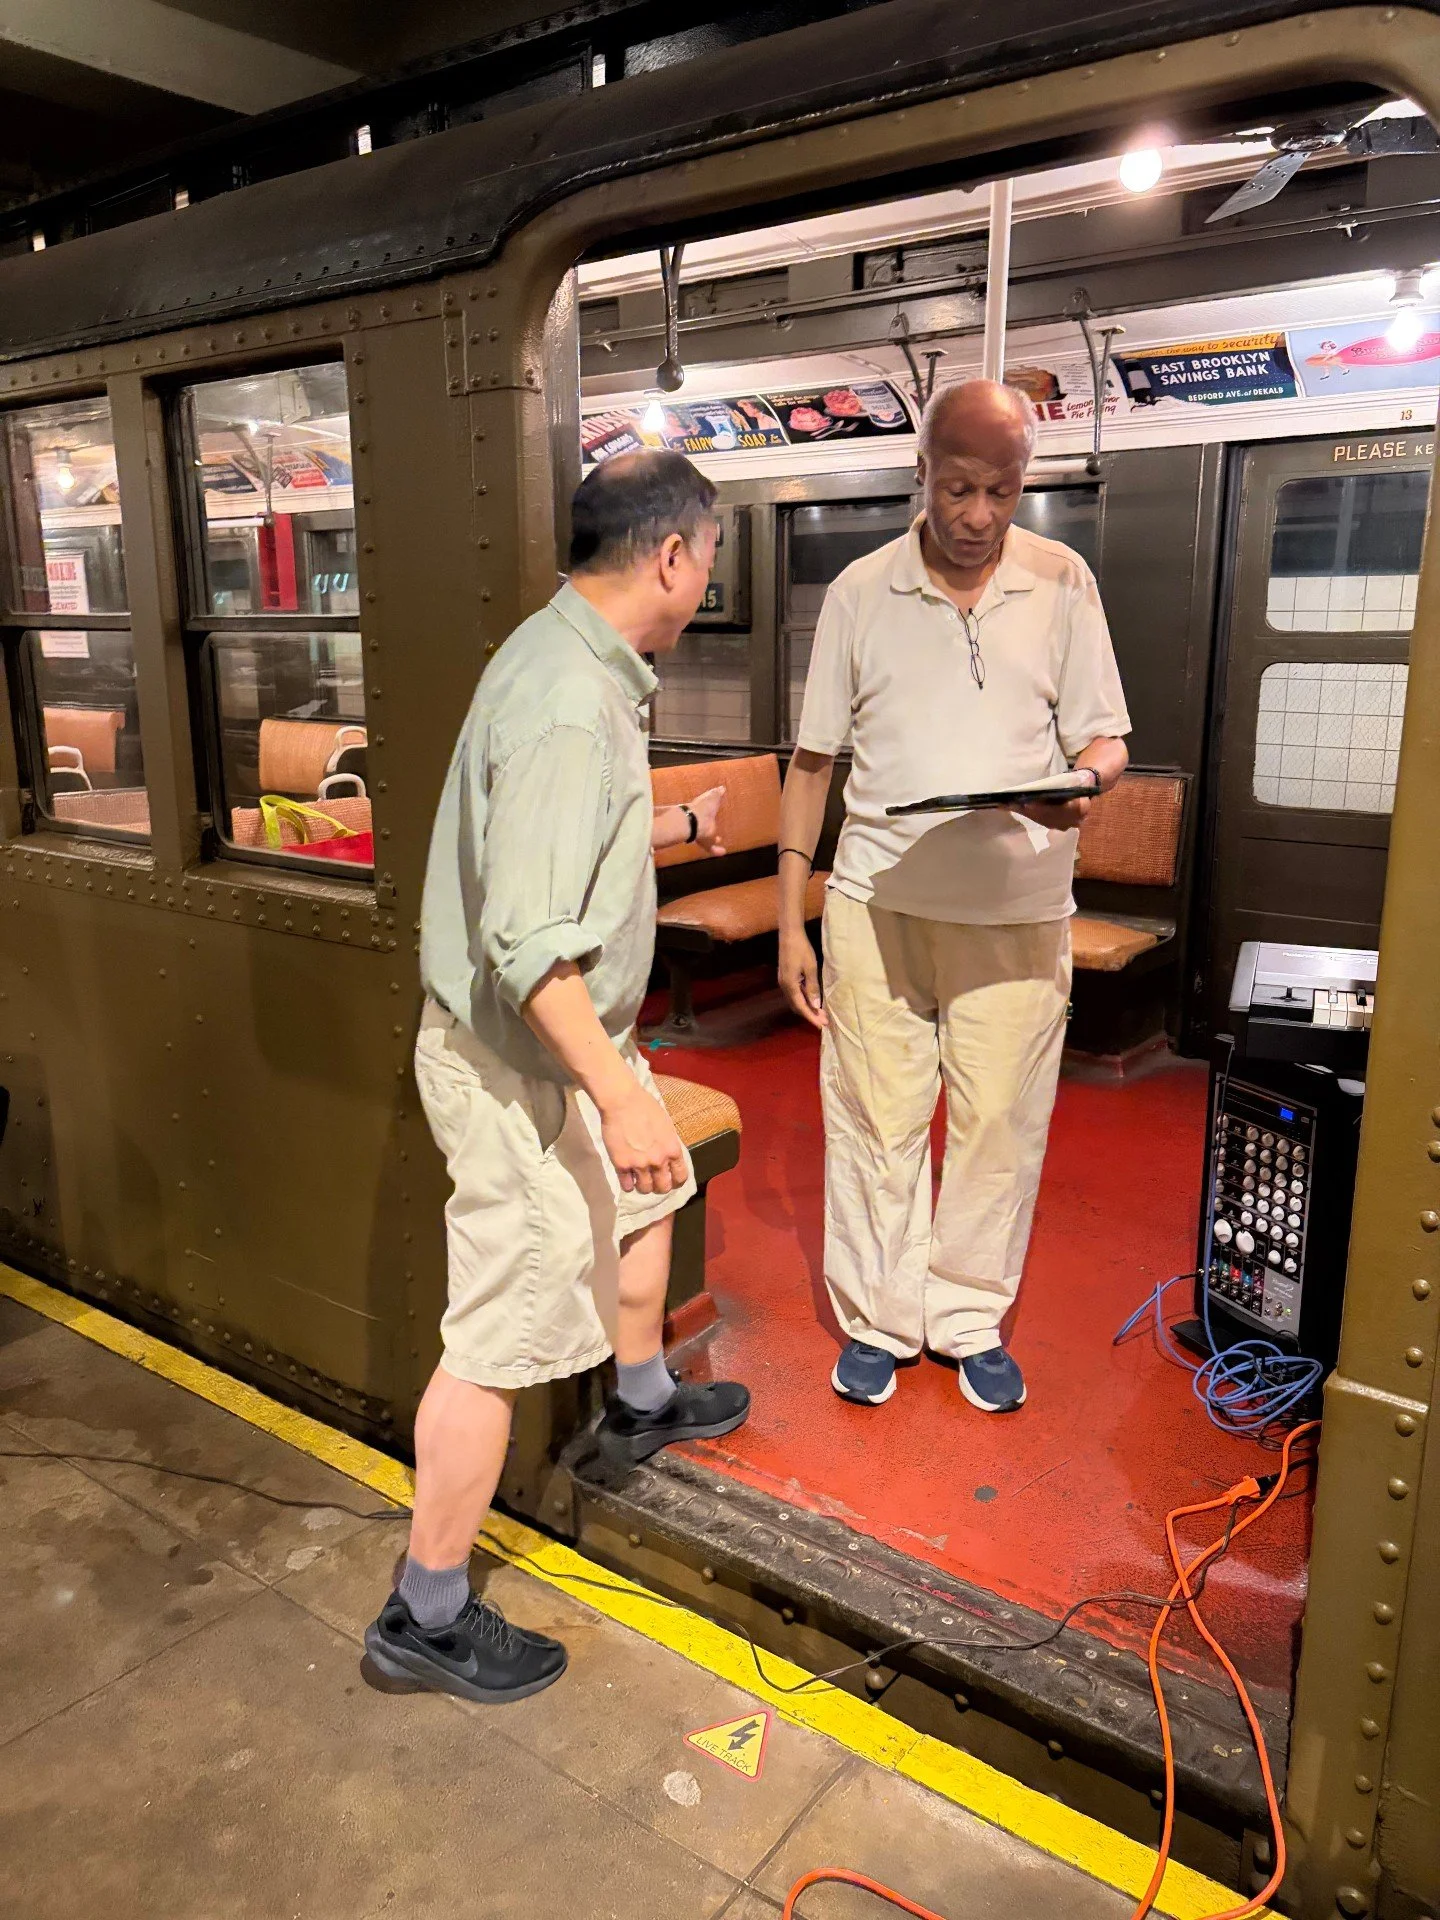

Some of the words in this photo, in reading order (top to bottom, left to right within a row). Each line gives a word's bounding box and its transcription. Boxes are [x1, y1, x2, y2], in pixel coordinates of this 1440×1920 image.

[1166, 347, 1181, 356] the
[1184, 345, 1205, 355] way
[1207, 341, 1219, 350] to
[1222, 333, 1280, 348] security
[1151, 361, 1186, 375] EAST
[1191, 351, 1271, 370] BROOKLYN
[1160, 370, 1220, 386] SAVINGS
[1226, 363, 1269, 379] BANK
[1187, 391, 1224, 402] BEDFORD
[1253, 387, 1284, 396] DEKALB
[1067, 399, 1094, 411] Lemon
[1070, 410, 1085, 419] Pie
[1399, 410, 1413, 421] 13
[683, 436, 714, 452] FAIRY
[737, 433, 767, 447] SOAP
[1333, 441, 1407, 462] PLEASE
[1414, 443, 1435, 456] KE
[696, 1736, 719, 1753] LIVE
[718, 1748, 752, 1772] TRACK
